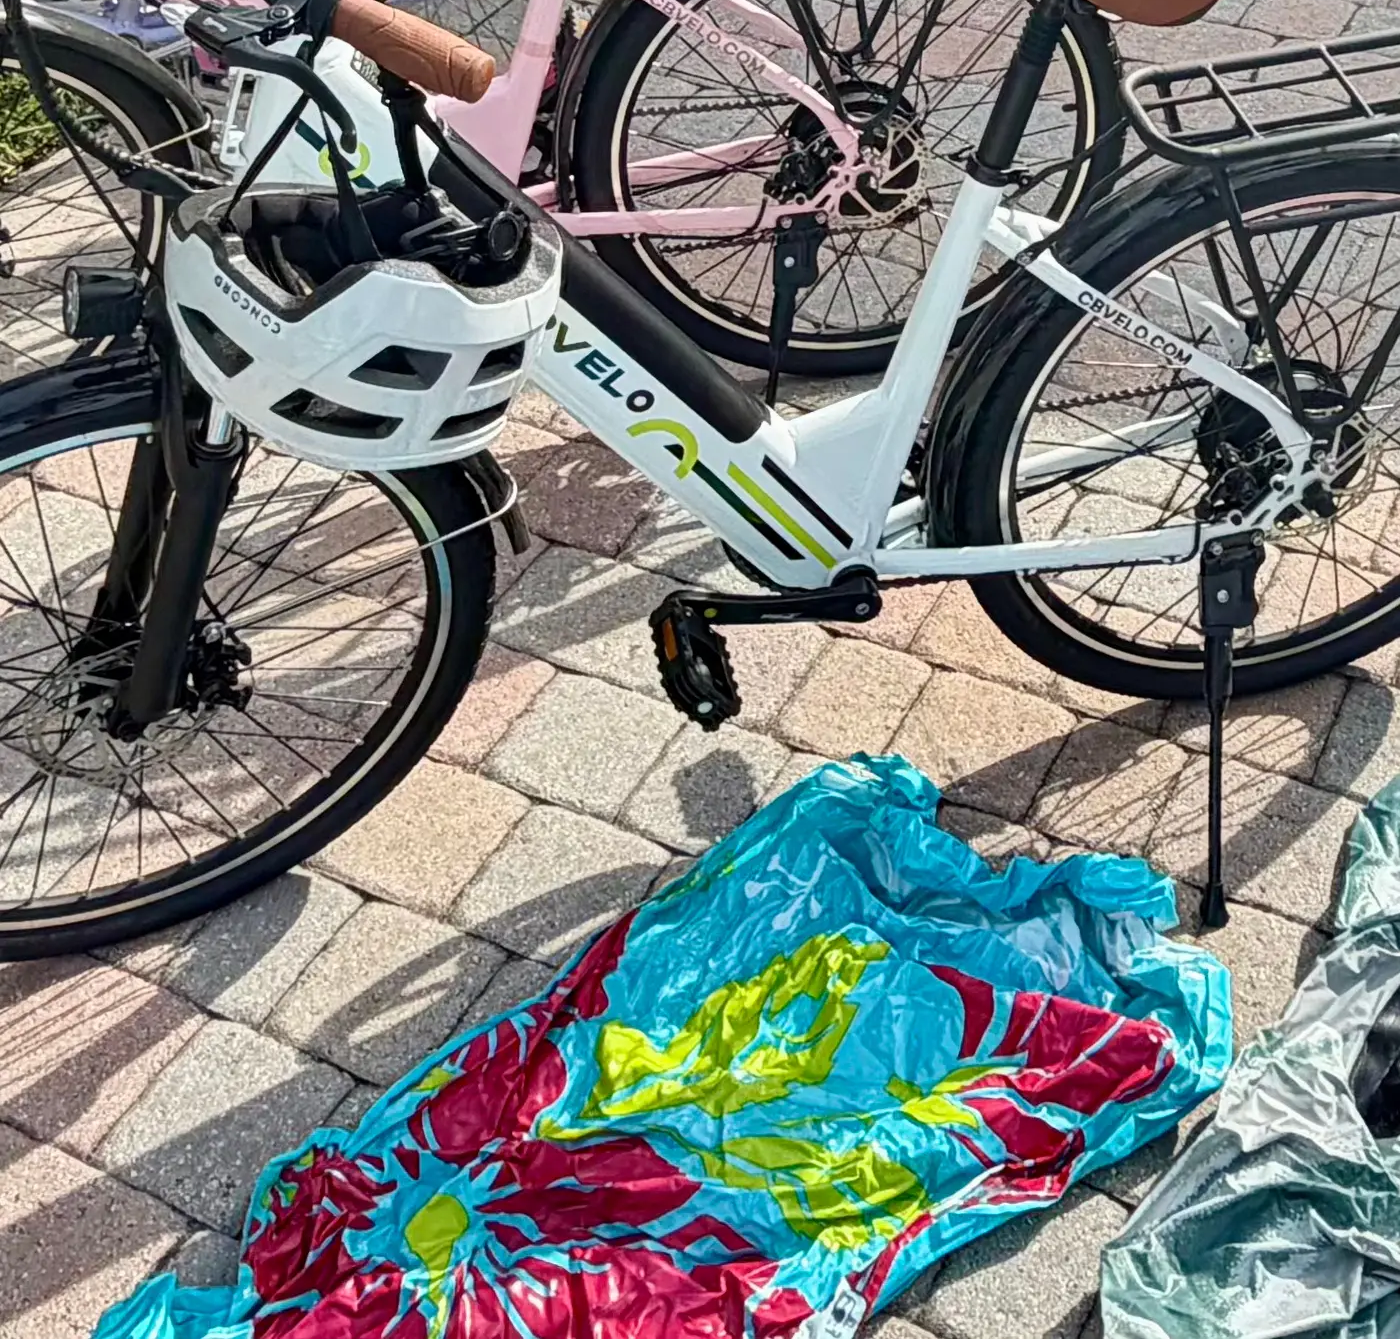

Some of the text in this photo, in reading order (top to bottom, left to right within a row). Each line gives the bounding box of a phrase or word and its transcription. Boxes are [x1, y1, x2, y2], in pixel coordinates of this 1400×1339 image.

[214, 274, 281, 334] CONCORD
[1077, 290, 1193, 365] CBVELO.COM
[545, 314, 655, 412] VELO
